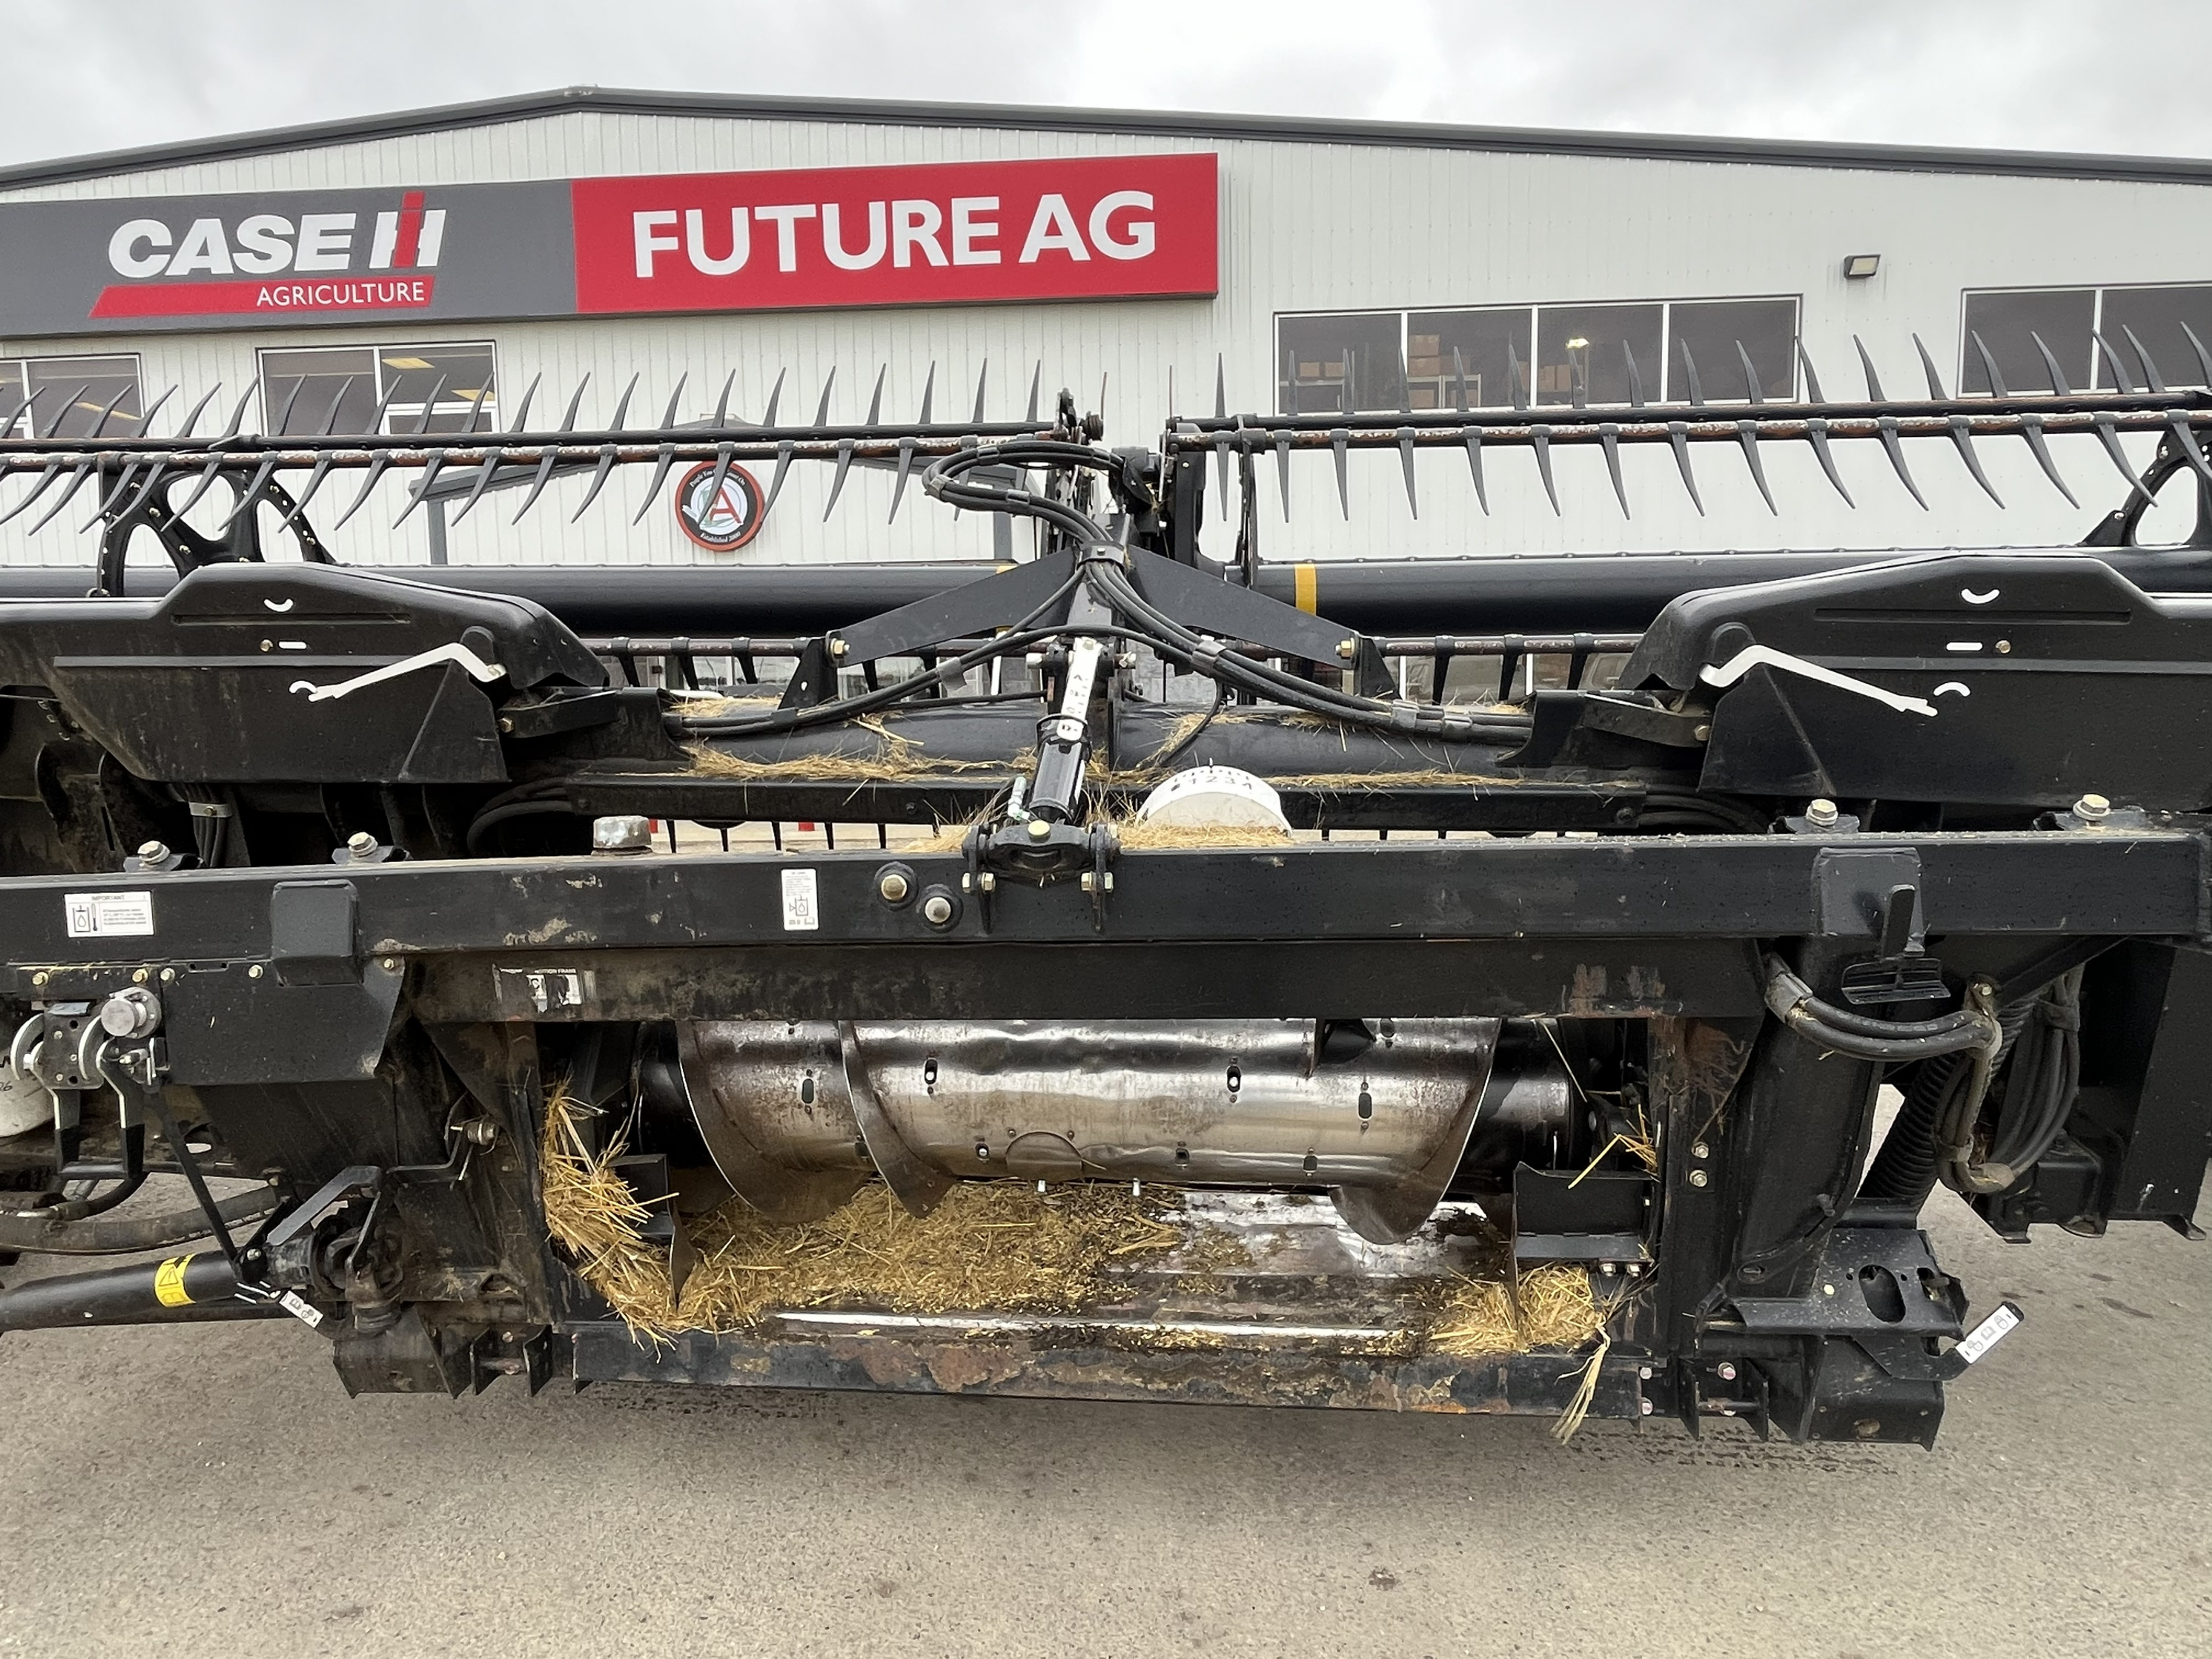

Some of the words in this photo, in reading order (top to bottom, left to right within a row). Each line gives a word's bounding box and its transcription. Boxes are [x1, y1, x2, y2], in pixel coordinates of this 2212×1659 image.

[109, 212, 357, 278] CASE
[633, 196, 1001, 279] FUTURE
[1019, 190, 1155, 264] AG
[256, 281, 425, 307] AGRICULTURE
